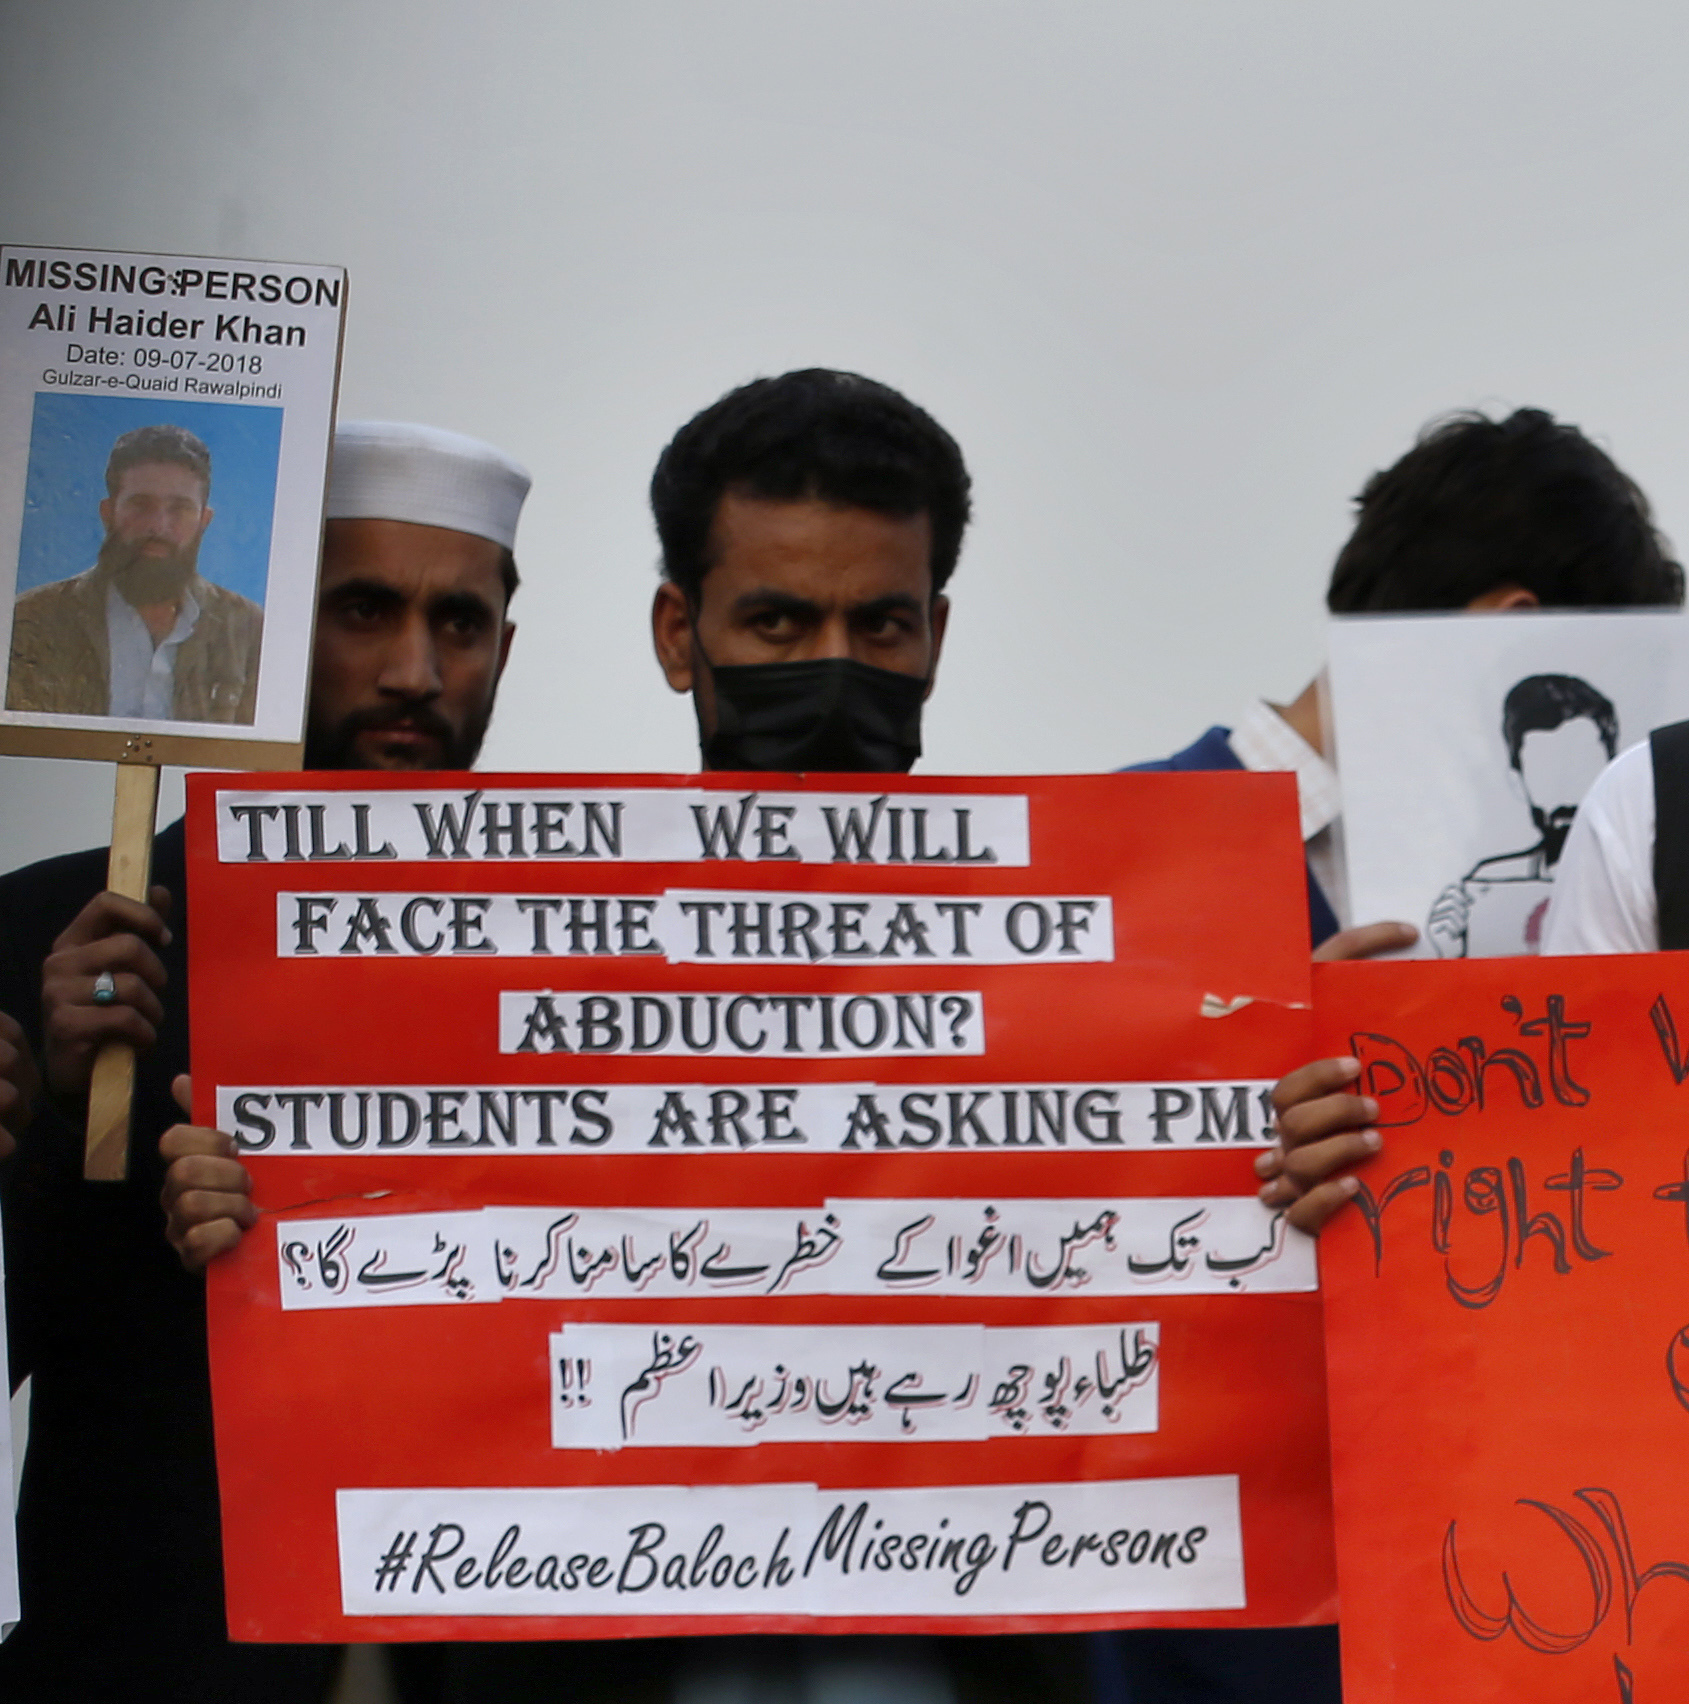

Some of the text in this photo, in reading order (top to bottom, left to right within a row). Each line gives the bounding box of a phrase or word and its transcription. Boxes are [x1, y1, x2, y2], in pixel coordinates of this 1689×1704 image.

[5, 258, 341, 307] MISSING PERSON
[28, 303, 306, 347] Ali Haider Khan
[42, 368, 282, 399] Gulzar-e-Quaid Rawalpindi
[66, 344, 263, 375] Date: 09-07-2018
[229, 790, 998, 864] TILL WHEN WE WILL
[292, 896, 1099, 963] FACE THE THREAT OF
[516, 995, 974, 1054] ABDUCTION?
[1350, 993, 1592, 1126] Don't
[232, 1089, 615, 1152] STUDENTS
[648, 1088, 808, 1152] ARE
[841, 1088, 1125, 1150] ASKING
[494, 1213, 580, 1287] کرنا
[567, 1234, 661, 1284] سامنا
[669, 1220, 704, 1280] کا
[699, 1213, 840, 1292] خطرے
[876, 1214, 938, 1281] کے
[1025, 1208, 1117, 1288] ہمیں
[1127, 1208, 1206, 1275] تک
[1355, 1146, 1623, 1309] right
[357, 1232, 466, 1299] پڑے
[816, 1359, 875, 1415] ہیں
[885, 1372, 973, 1428] رہے
[989, 1358, 1065, 1428] پوچھ
[375, 1500, 1207, 1596] #ReleaseBalochMissingPersons
